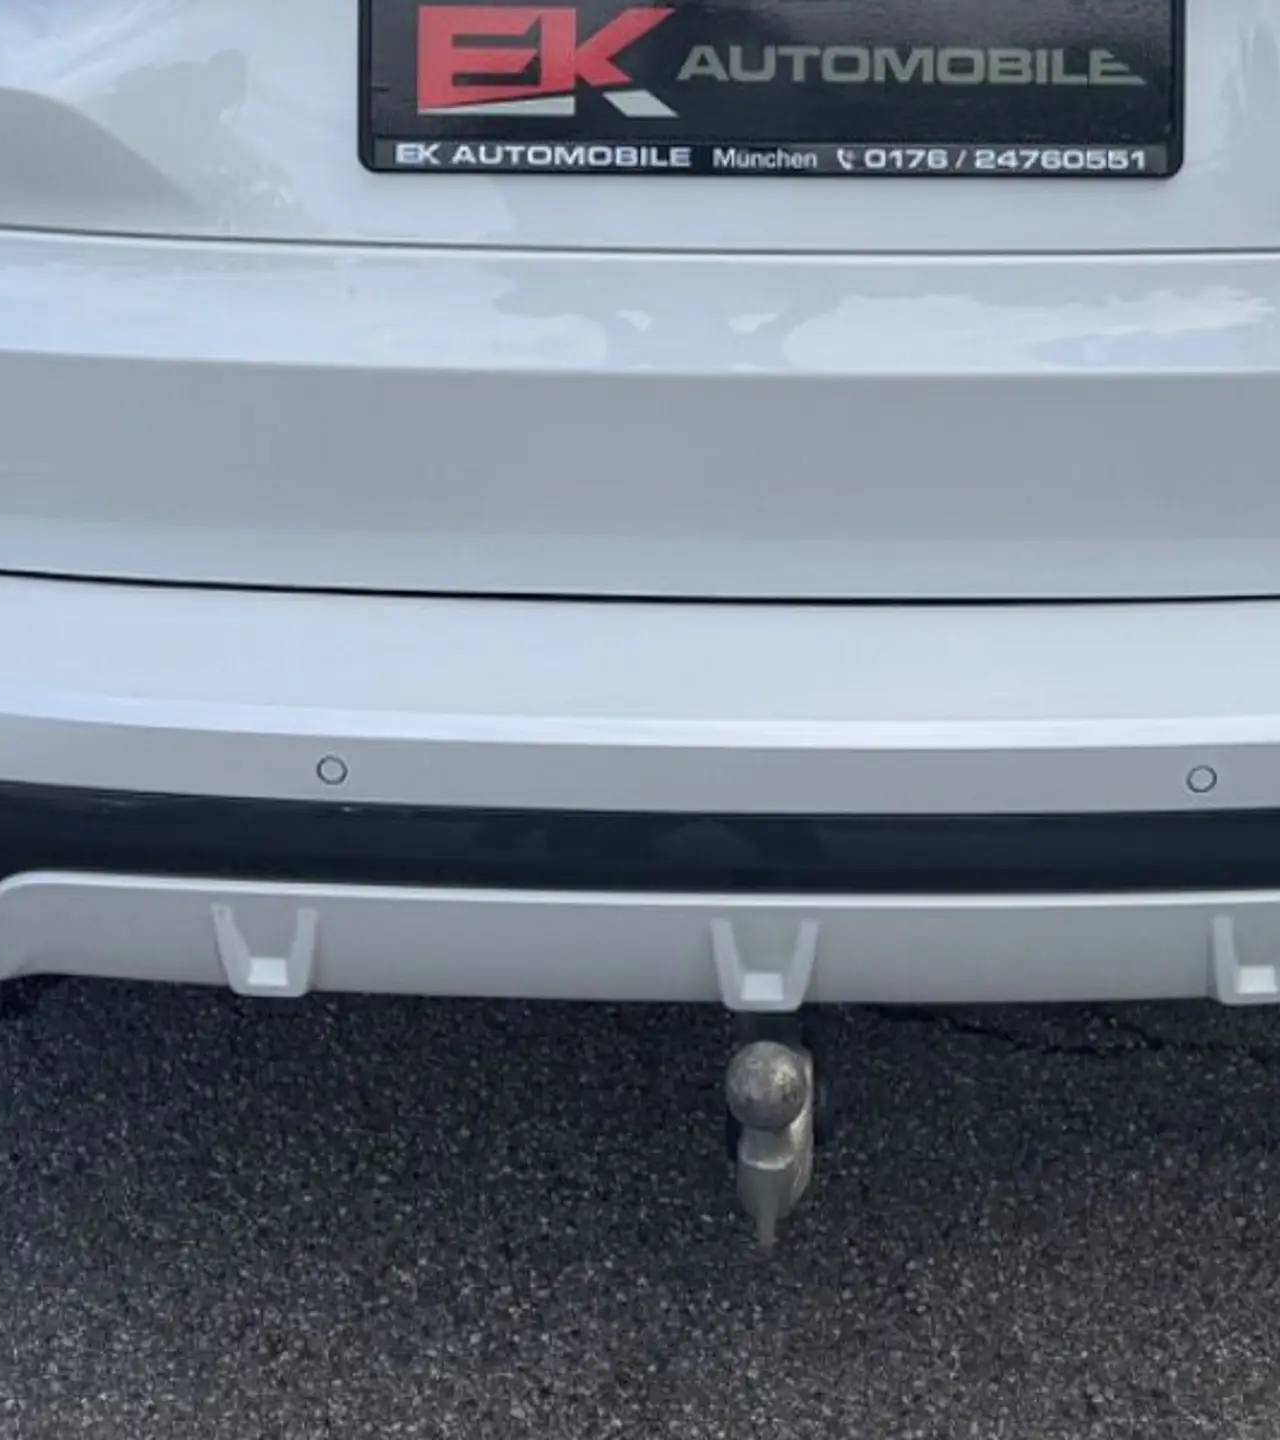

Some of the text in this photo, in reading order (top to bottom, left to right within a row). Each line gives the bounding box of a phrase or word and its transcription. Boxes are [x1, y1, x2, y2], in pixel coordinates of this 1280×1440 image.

[417, 4, 1147, 118] EK AUTOMOBILE
[394, 142, 441, 165] EK
[451, 143, 692, 168] AUTOMOBILE
[712, 147, 818, 169] München
[974, 148, 1147, 171] 24760551
